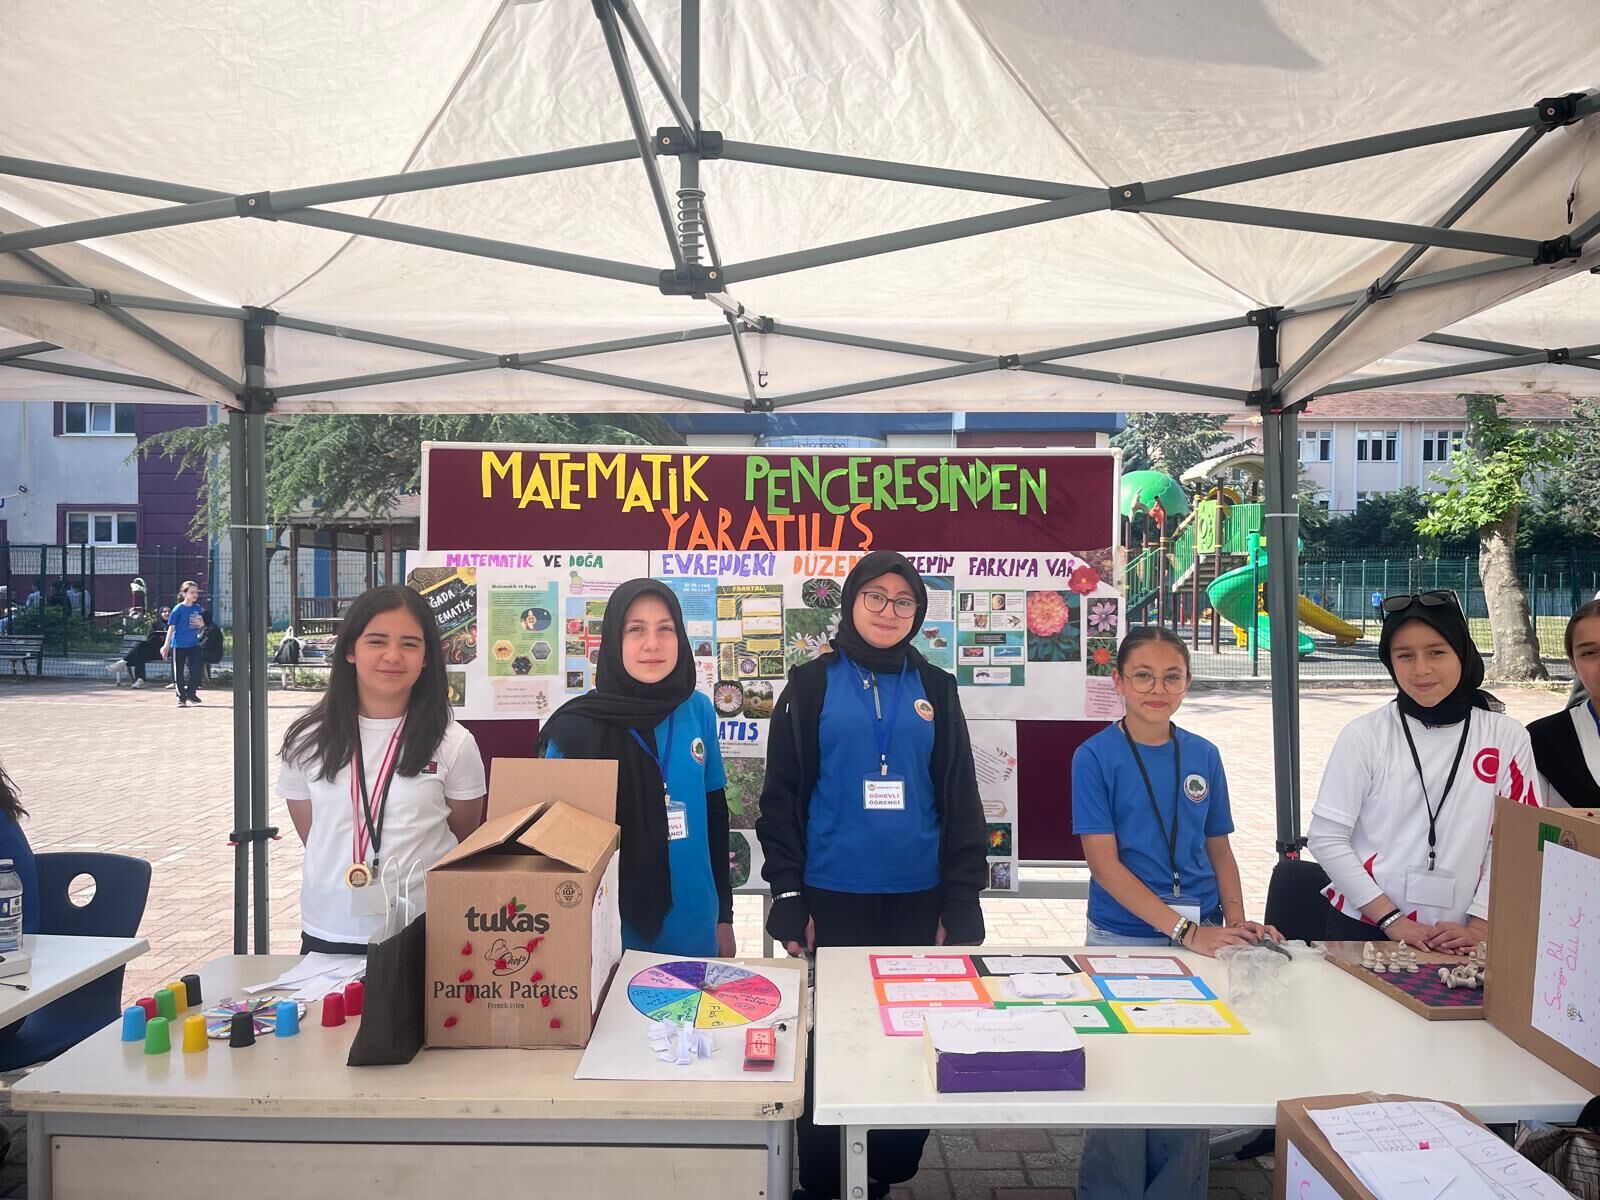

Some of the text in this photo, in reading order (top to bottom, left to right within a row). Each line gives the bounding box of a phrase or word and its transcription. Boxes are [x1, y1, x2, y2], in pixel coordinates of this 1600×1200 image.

[746, 455, 1048, 515] PENCERESİNDEN
[661, 503, 874, 554] YARATILIŞ
[543, 555, 562, 568] VE
[569, 552, 604, 569] DOĞA
[662, 551, 777, 577] EVRENDEKİ
[426, 589, 456, 609] ĞADA
[717, 720, 759, 743] ATIŞ
[464, 906, 551, 935] tukaş
[433, 980, 578, 1000] Parmak Patates
